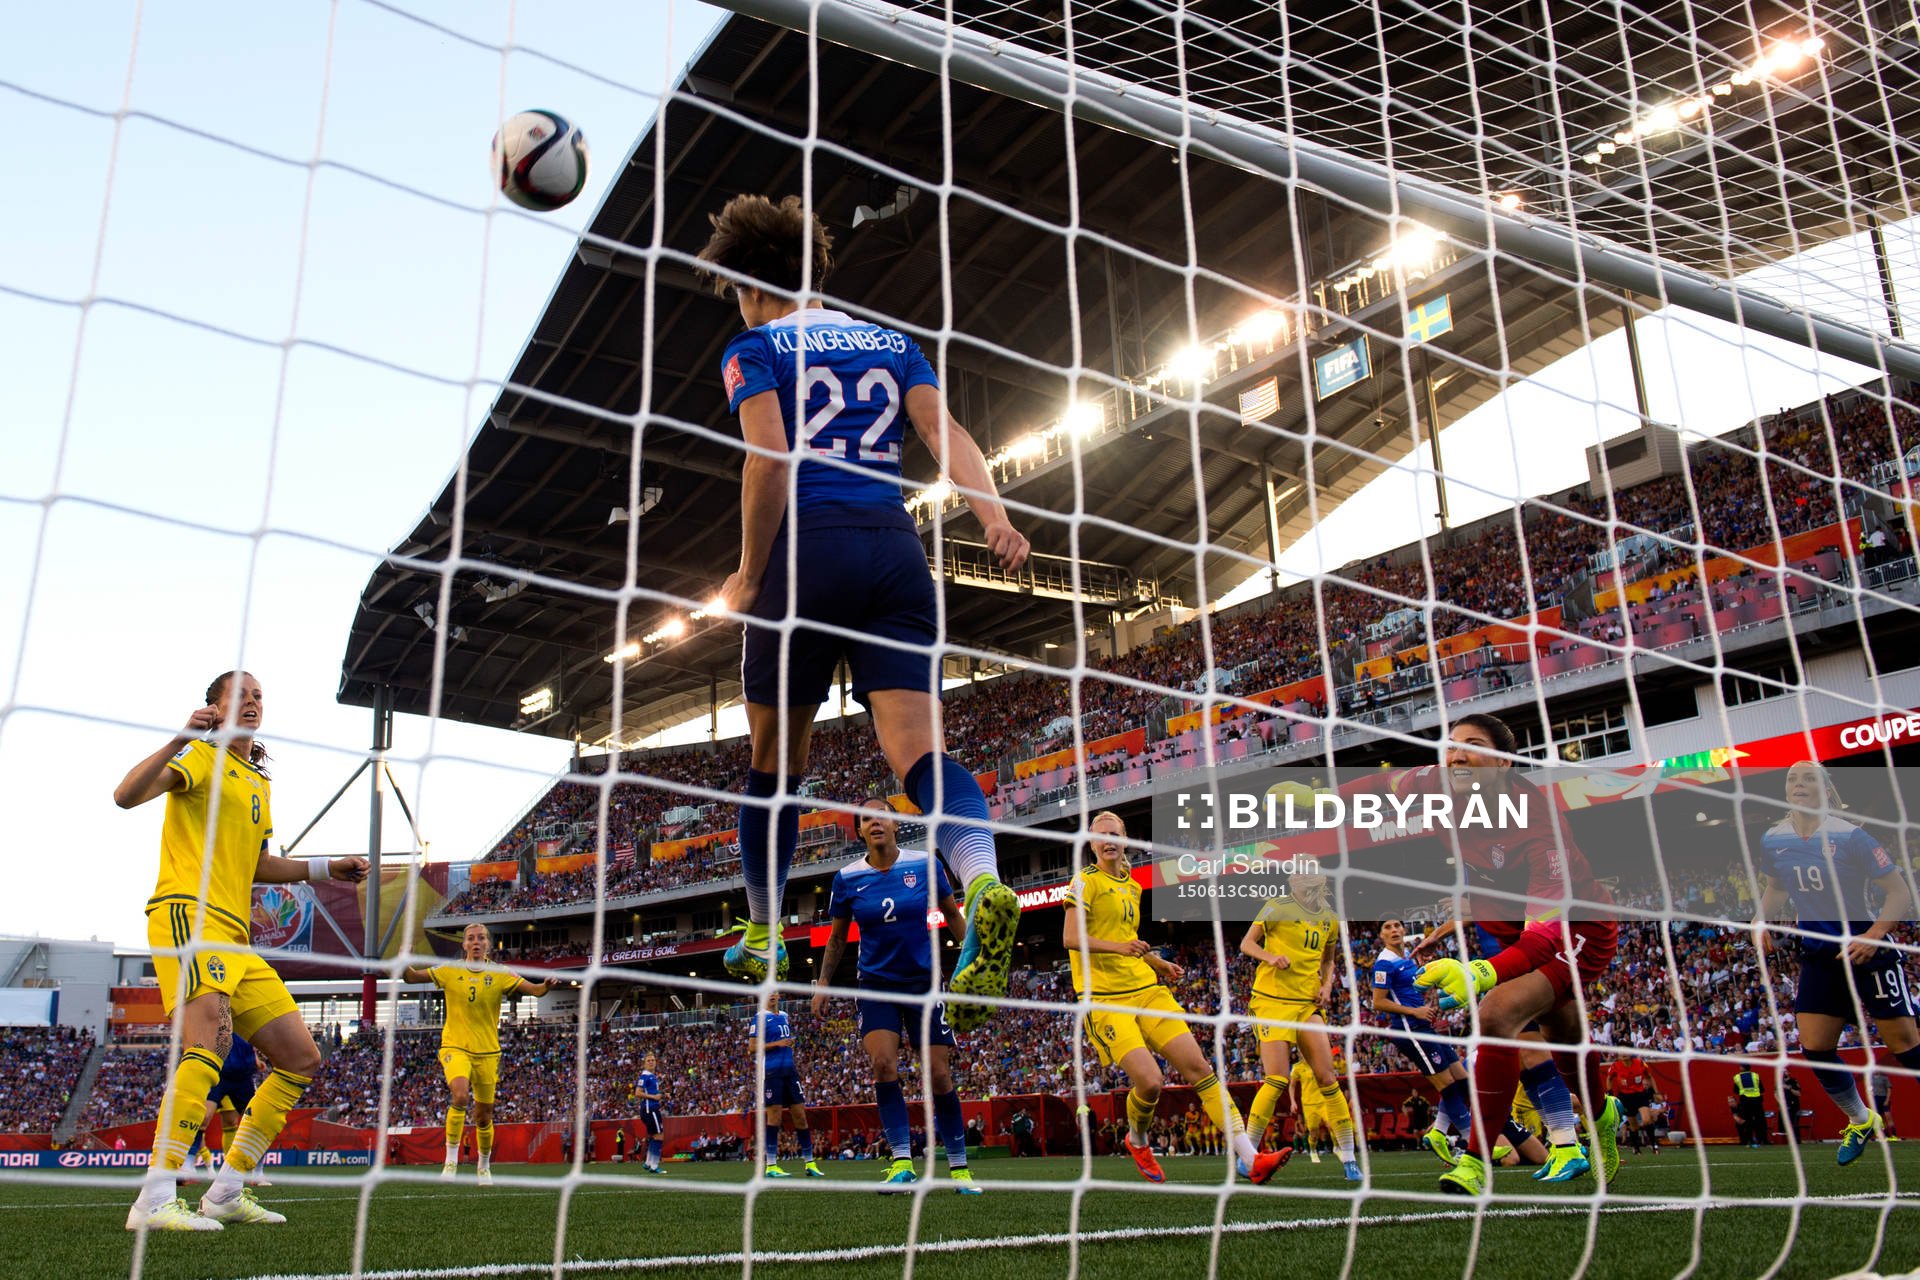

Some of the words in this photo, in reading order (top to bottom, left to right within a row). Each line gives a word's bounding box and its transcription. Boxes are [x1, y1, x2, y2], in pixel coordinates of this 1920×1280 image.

[1324, 349, 1360, 379] FIFA
[796, 366, 900, 463] 22
[1840, 715, 1920, 749] COUPE
[252, 794, 260, 824] 8
[1793, 866, 1824, 892] 19
[881, 897, 896, 923] 2
[1122, 899, 1134, 922] 14
[288, 944, 309, 952] FIFA
[1304, 930, 1319, 950] 10
[602, 953, 609, 962] A
[612, 948, 653, 961] GREATER
[655, 945, 677, 957] GOAL
[468, 986, 476, 1002] 3
[1871, 970, 1900, 998] 19
[778, 1024, 790, 1037] 10
[307, 1151, 368, 1165] FIFA.com
